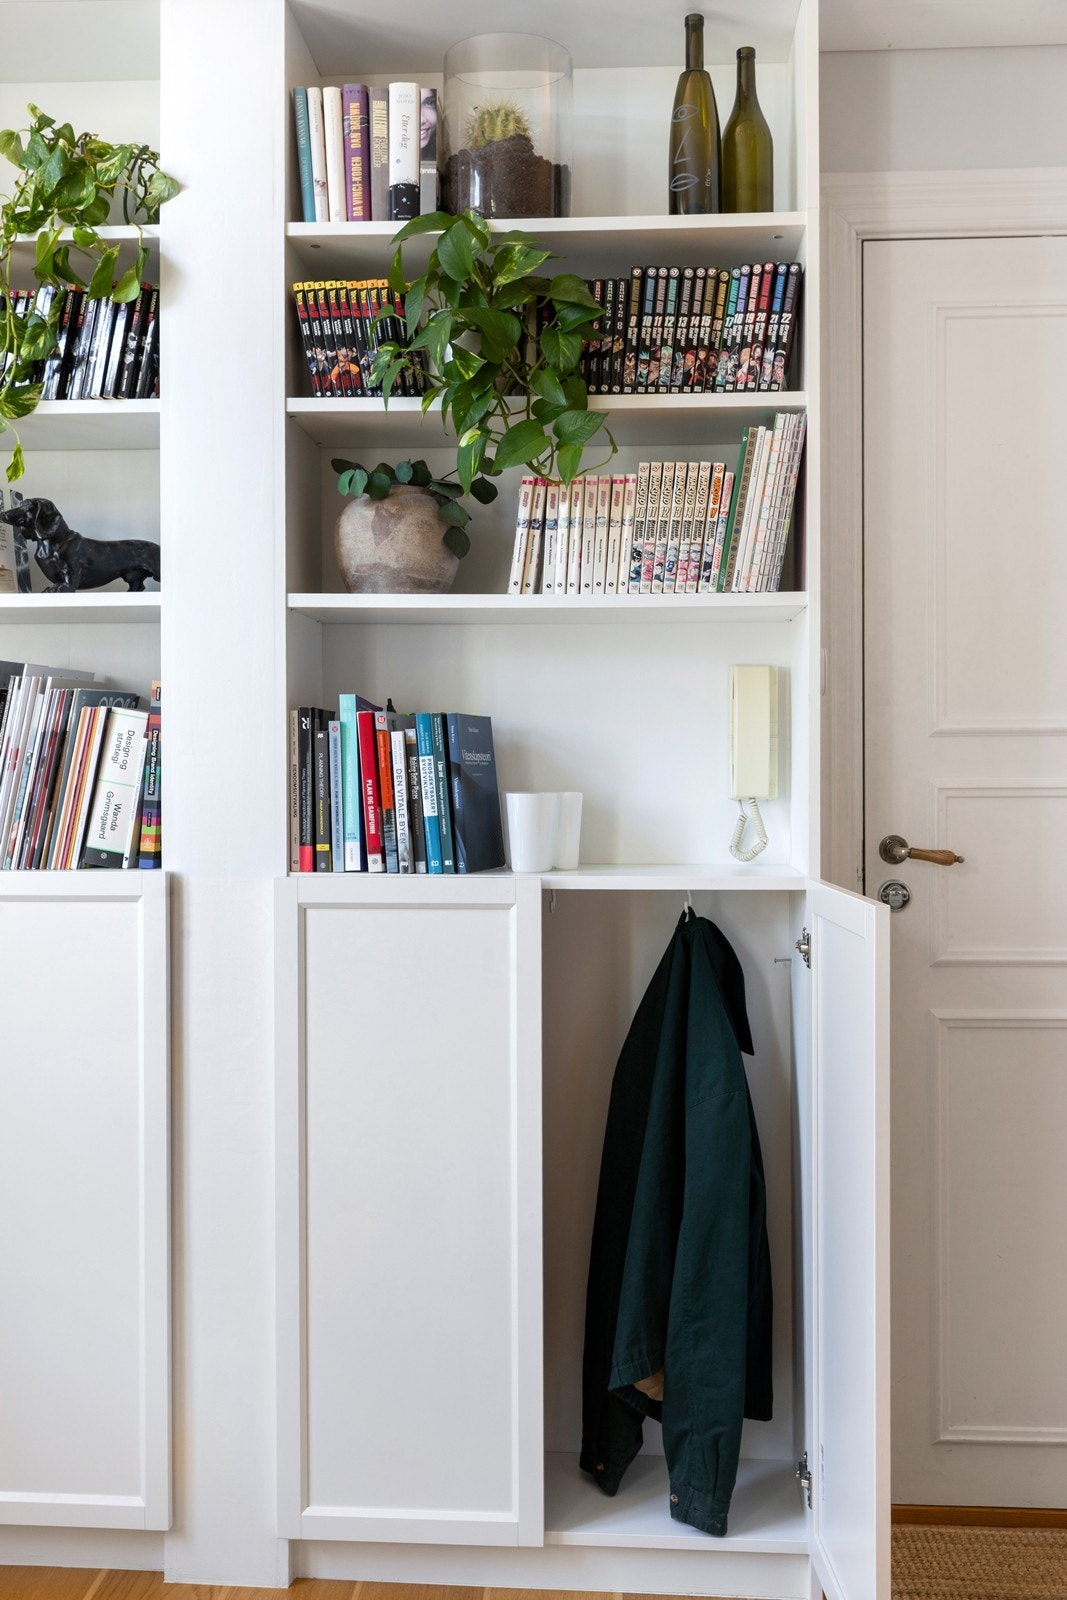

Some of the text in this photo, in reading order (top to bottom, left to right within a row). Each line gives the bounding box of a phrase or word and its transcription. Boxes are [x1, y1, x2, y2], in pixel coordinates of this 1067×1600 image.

[296, 95, 304, 119] HANNA
[350, 102, 361, 130] BROWN
[373, 109, 387, 138] ALLENDE
[399, 114, 410, 149] Etter deg
[351, 133, 361, 148] DAN
[351, 157, 363, 216] DA VINCI-KODEN
[630, 316, 637, 326] 9
[643, 316, 652, 326] 10
[654, 316, 663, 326] 11
[665, 316, 675, 327] 12
[678, 316, 688, 327] 13
[690, 316, 700, 326] 14
[701, 316, 712, 326] 15
[725, 316, 734, 327] 17
[734, 313, 744, 324] 18
[746, 313, 755, 323] 19
[756, 312, 766, 321] 20
[770, 314, 779, 323] 21
[781, 313, 792, 323] 22
[713, 320, 722, 330] 16
[636, 476, 648, 518] NARUTO 10
[649, 475, 659, 518] NARUTO 11
[661, 476, 672, 518] NARUTO 12
[673, 475, 684, 518] NARUTO 13
[685, 476, 696, 518] NARUTO 14
[696, 475, 707, 518] NARUTO 15
[712, 476, 721, 505] NARUTO
[112, 733, 123, 764] strategi
[120, 730, 135, 770] Design og
[409, 756, 418, 772] Making
[367, 795, 374, 804] OG
[99, 791, 114, 840] Grimsgaard
[110, 803, 122, 831] Wanda
